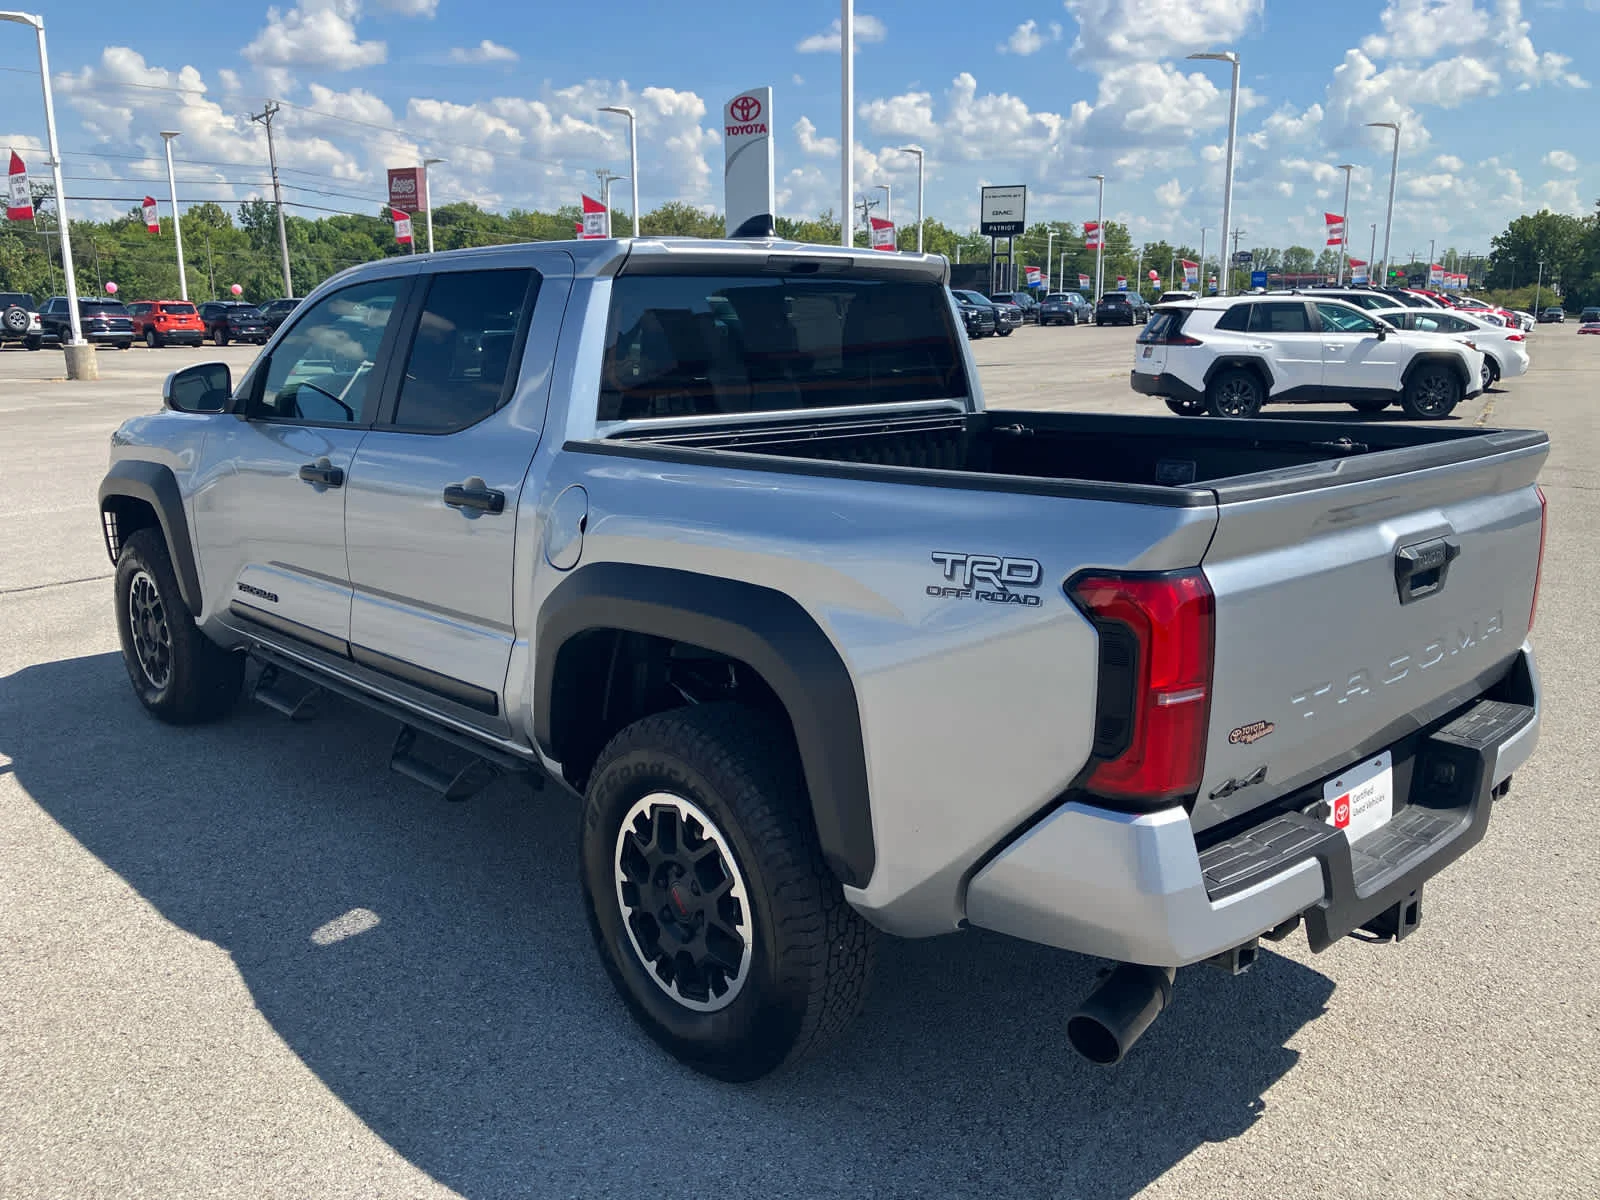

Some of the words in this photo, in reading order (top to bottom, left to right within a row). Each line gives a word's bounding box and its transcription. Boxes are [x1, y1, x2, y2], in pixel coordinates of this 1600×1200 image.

[726, 124, 767, 136] TOYOTA
[931, 551, 1042, 591] TRD
[926, 585, 972, 600] OFF
[975, 590, 1042, 607] ROAD
[1291, 608, 1503, 718] TACOMA
[1241, 721, 1265, 737] TOYOTA
[1352, 786, 1374, 803] Certified
[1352, 804, 1366, 816] Used
[1366, 794, 1384, 808] Vehicles
